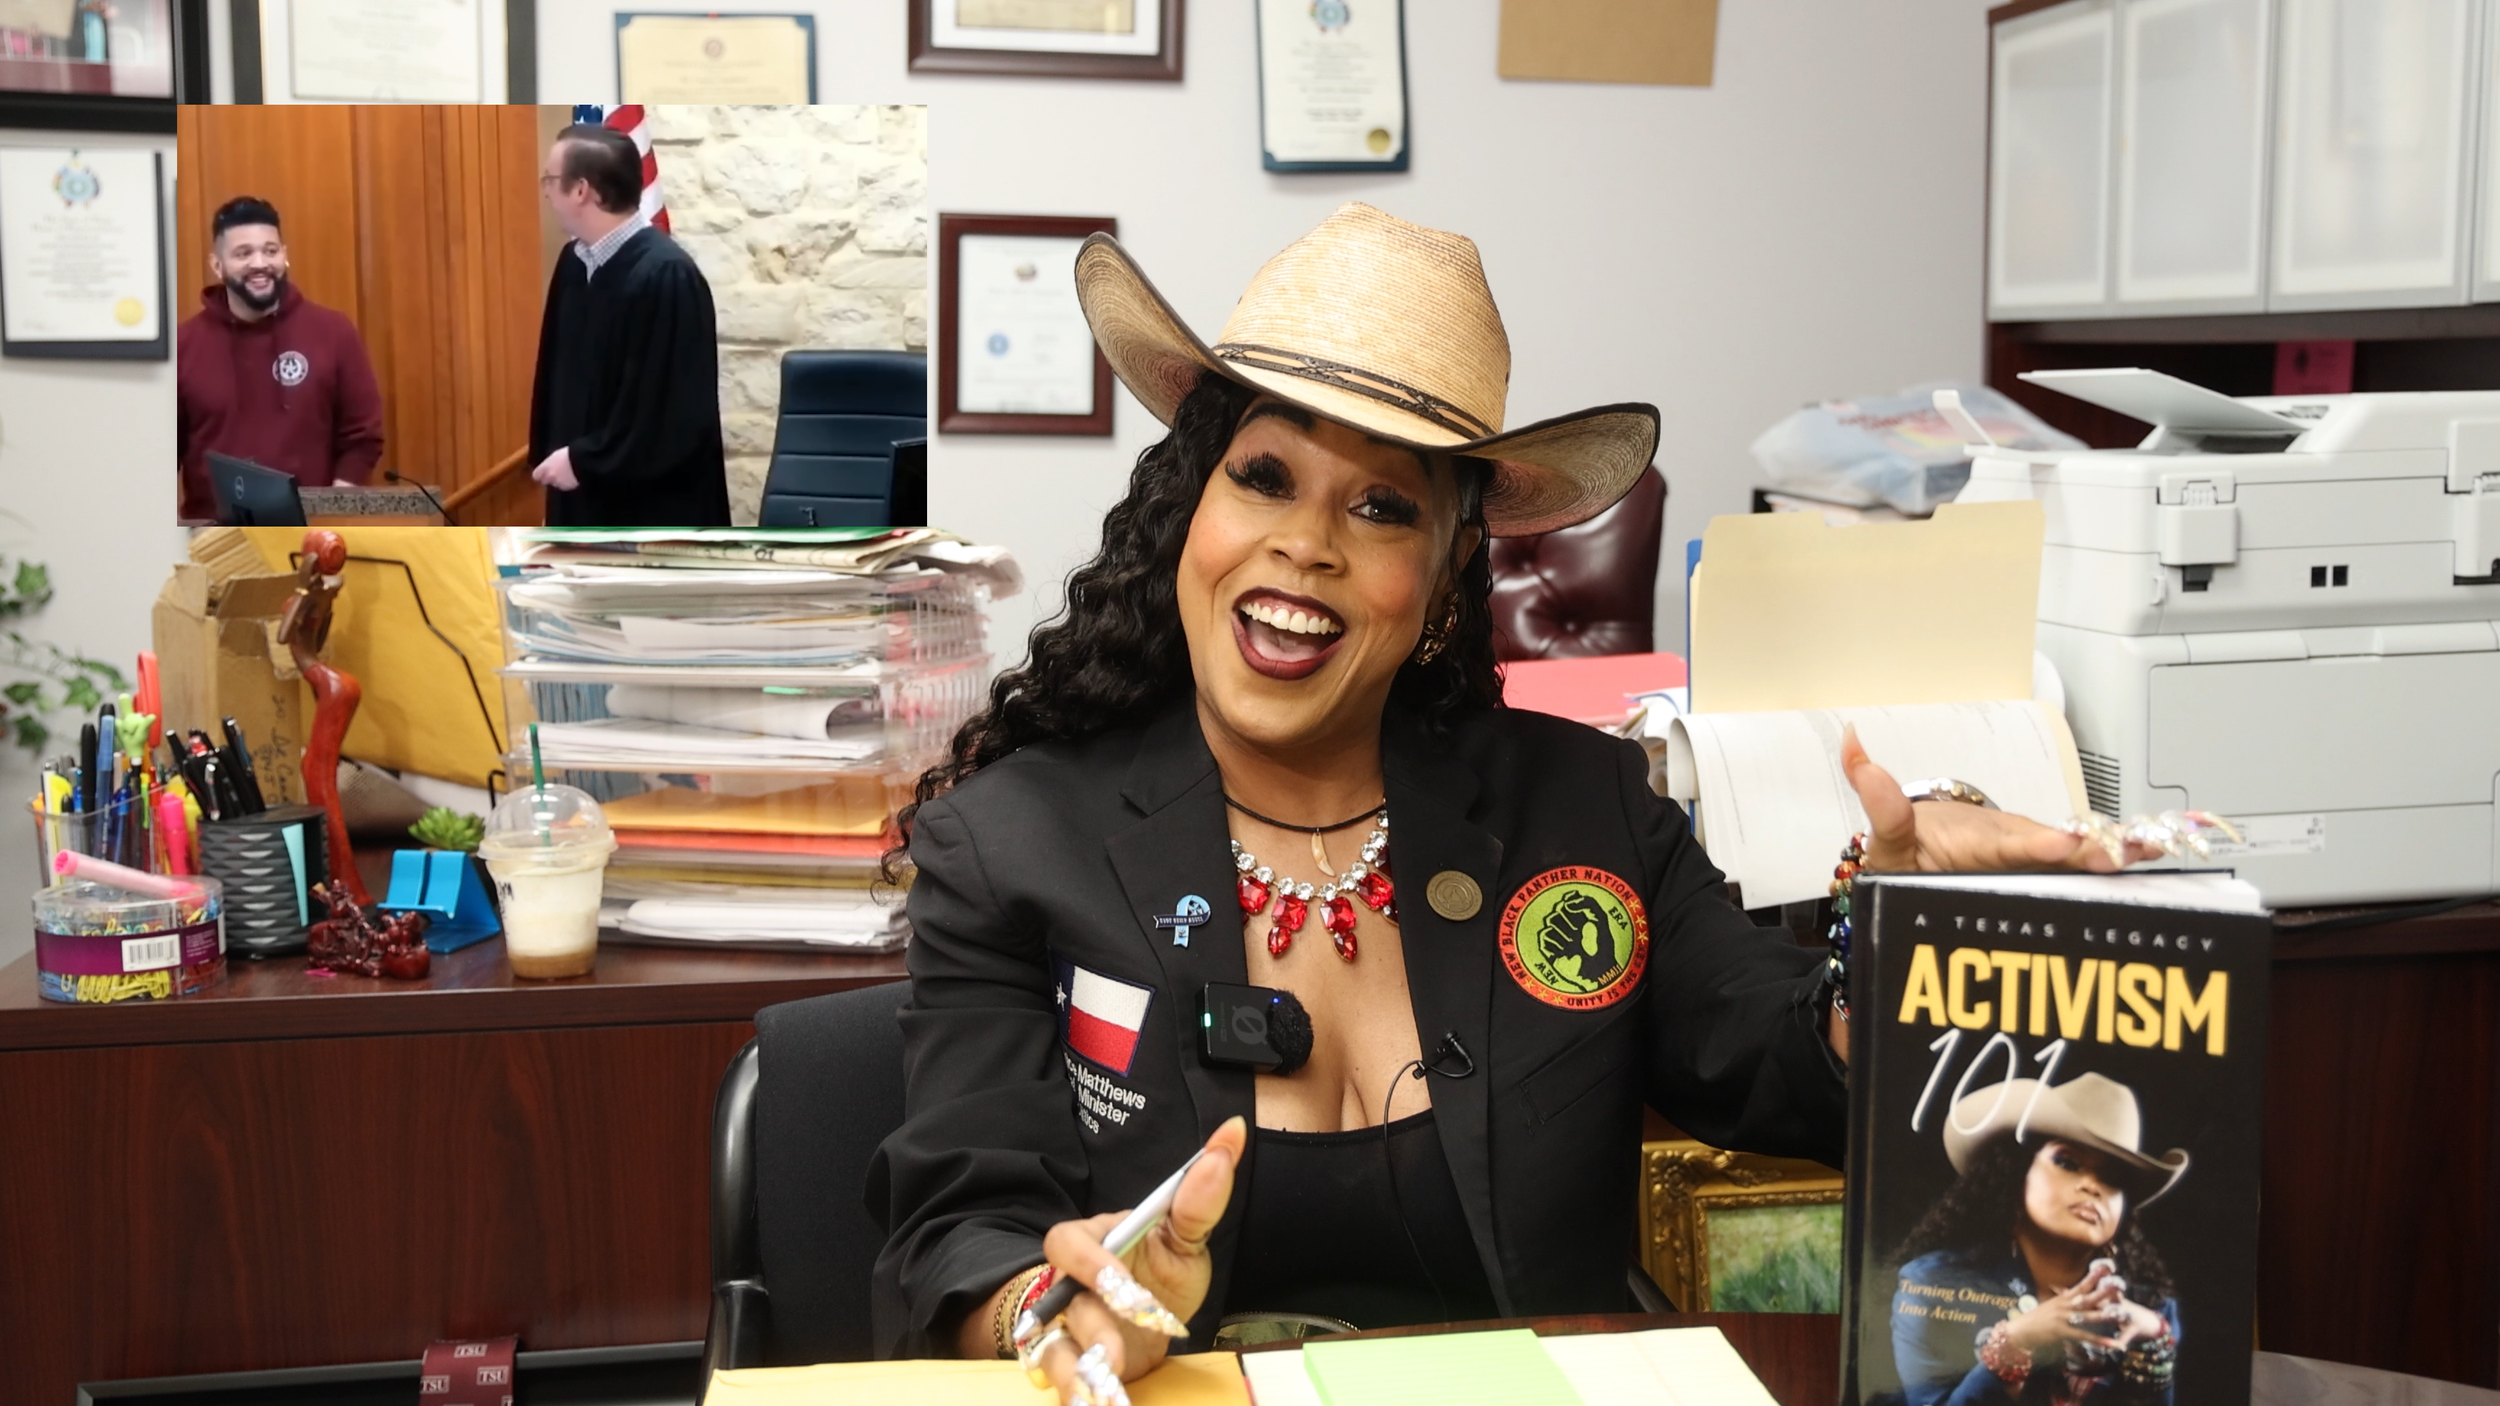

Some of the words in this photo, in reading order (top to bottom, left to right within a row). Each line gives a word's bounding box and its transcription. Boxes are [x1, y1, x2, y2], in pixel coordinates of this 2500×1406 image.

[1517, 868, 1578, 901] PANTHER
[1584, 869, 1634, 901] NATION
[1502, 905, 1520, 945] BLACK
[1608, 906, 1629, 931] ERA
[1914, 913, 1927, 927] A
[1954, 916, 2055, 938] TEXAS
[2083, 927, 2214, 952] LEGACY
[1505, 952, 1526, 980] NEW
[1534, 962, 1559, 986] NEW
[1566, 995, 1604, 1008] UNITY
[1607, 988, 1620, 1001] IS
[1620, 970, 1638, 990] THE
[1898, 943, 2229, 1057] ACTIVISM
[1078, 1063, 1146, 1110] Matthews
[1911, 1028, 2066, 1144] 101
[1078, 1083, 1130, 1126] Minister
[1900, 1279, 1955, 1303] Turning
[1957, 1287, 2018, 1310] Outrage
[1898, 1301, 1928, 1317] Into
[1930, 1305, 1978, 1324] Action
[459, 1345, 482, 1356] TSU
[421, 1379, 444, 1393] TSU
[480, 1369, 504, 1384] TSU
